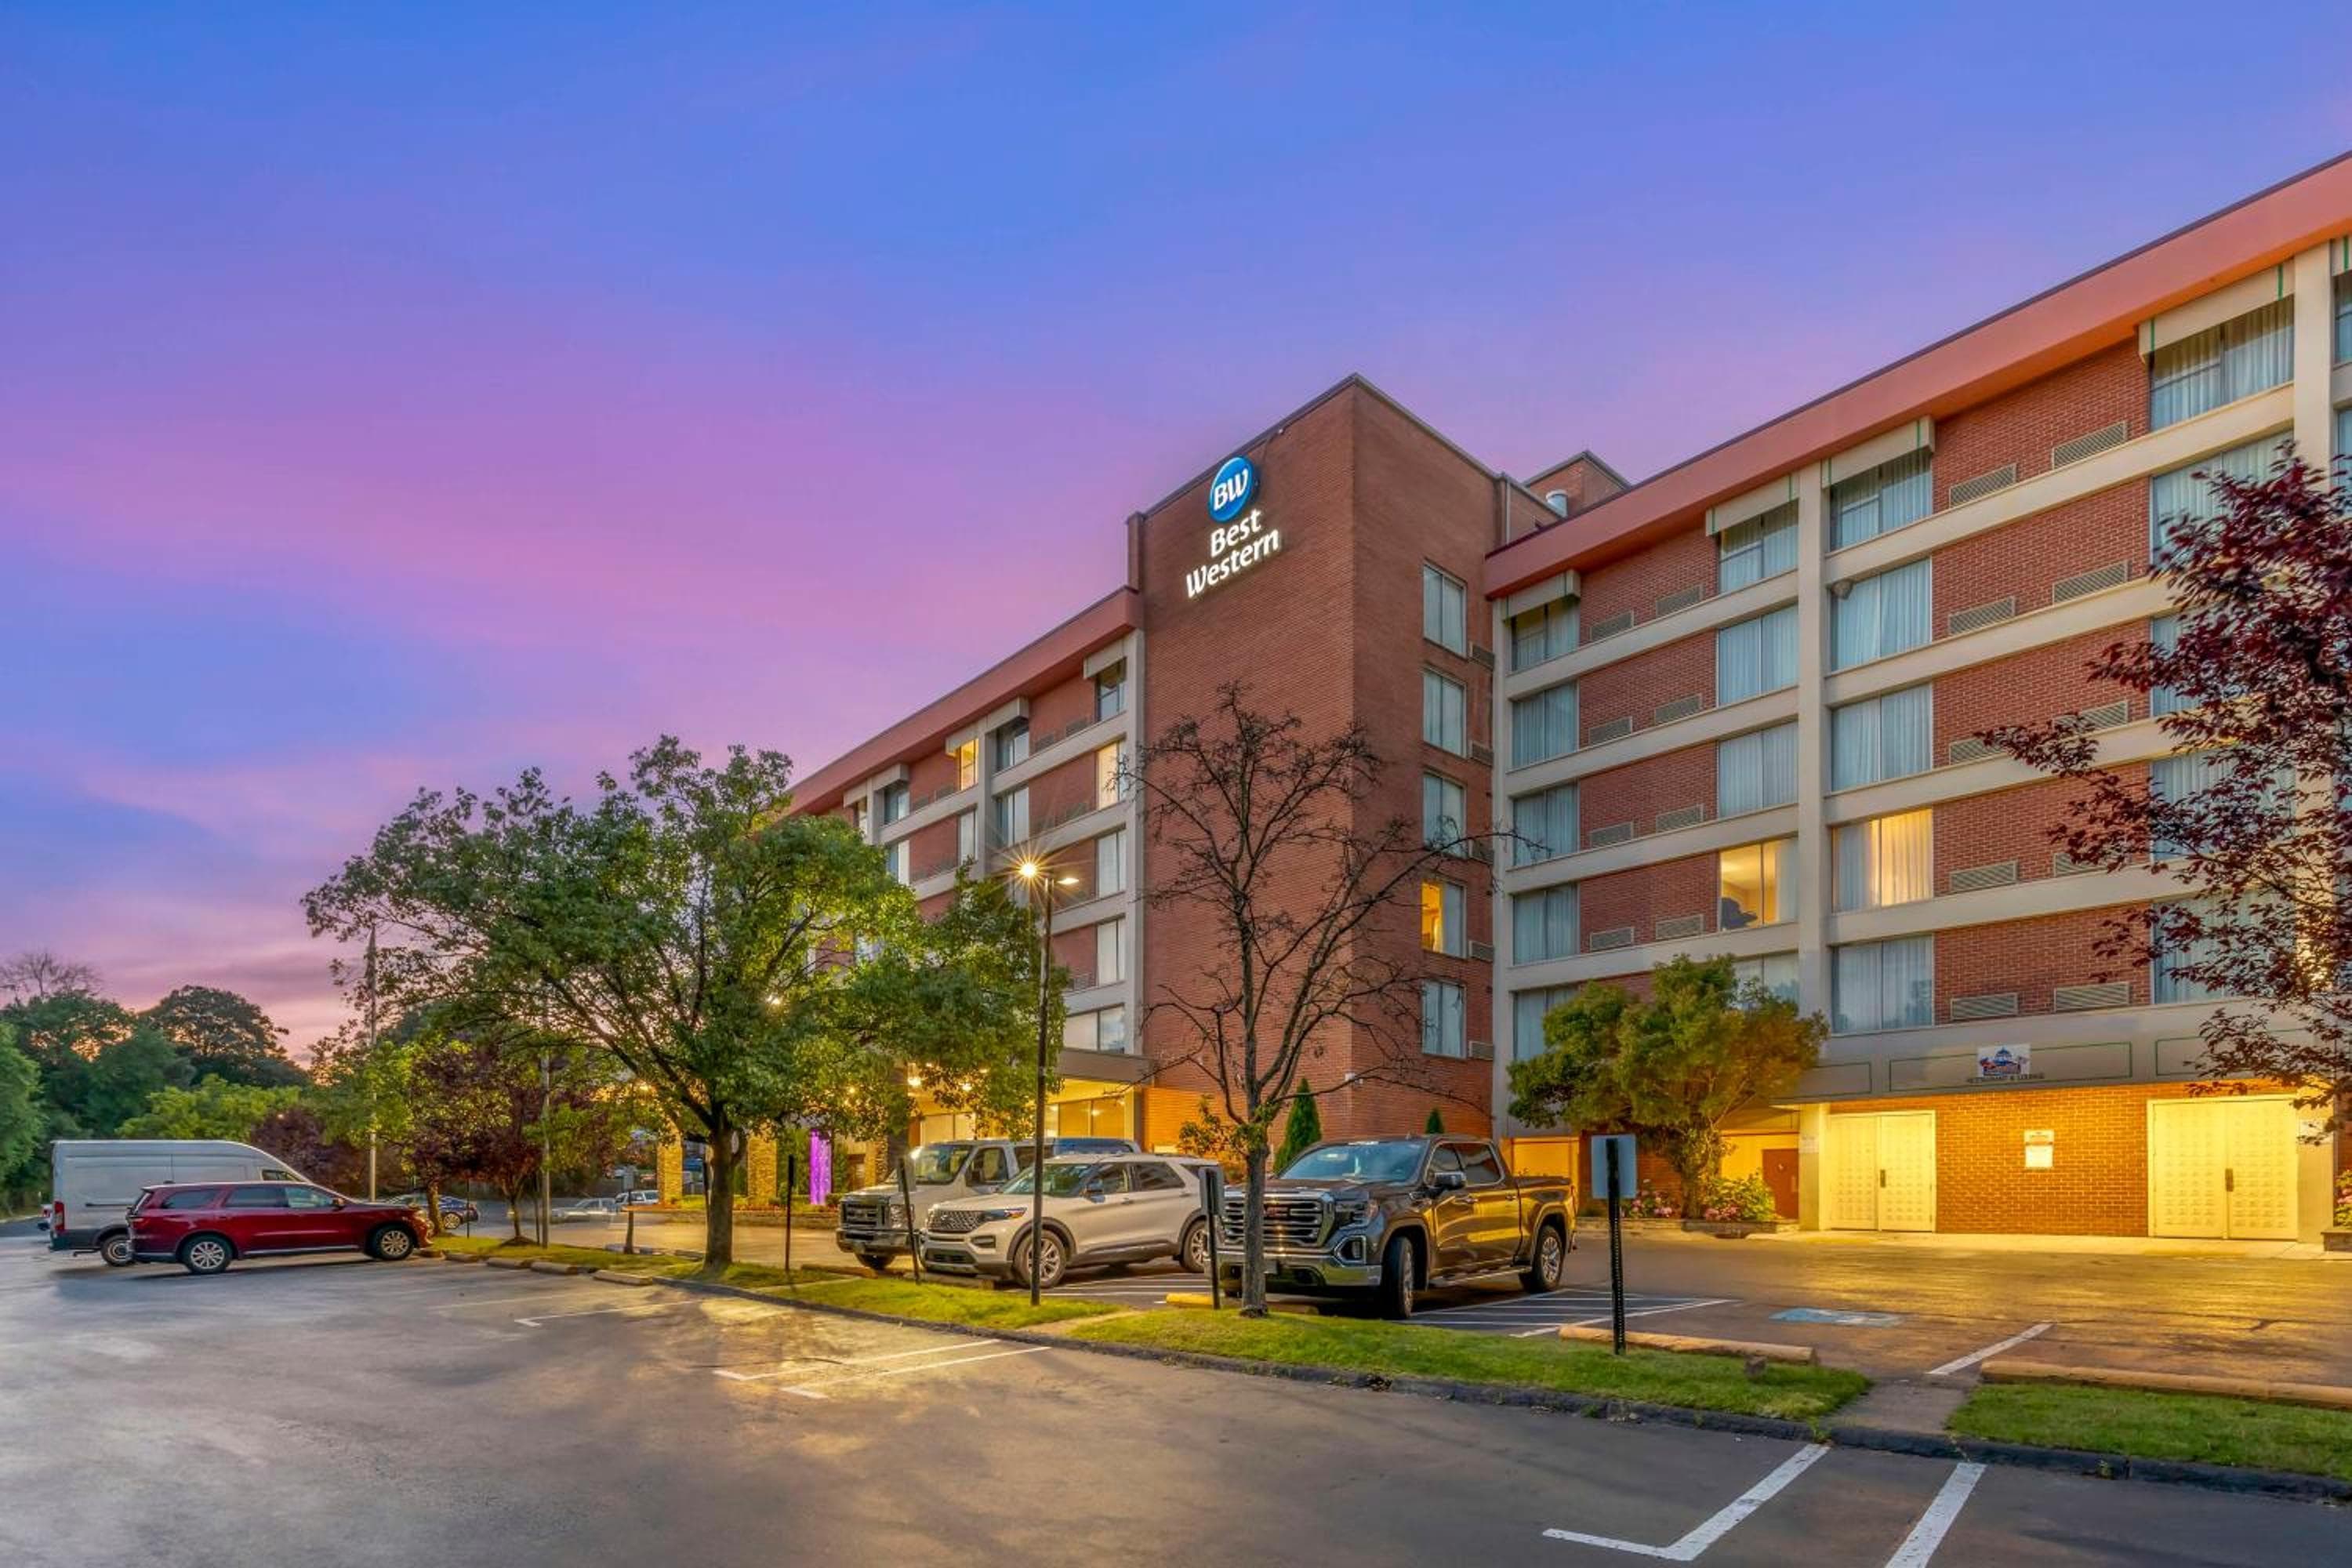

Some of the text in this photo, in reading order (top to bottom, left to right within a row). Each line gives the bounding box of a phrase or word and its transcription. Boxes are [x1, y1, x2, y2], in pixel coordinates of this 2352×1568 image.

[1214, 469, 1248, 510] BW
[1210, 509, 1261, 557] Best
[1185, 529, 1279, 598] Western
